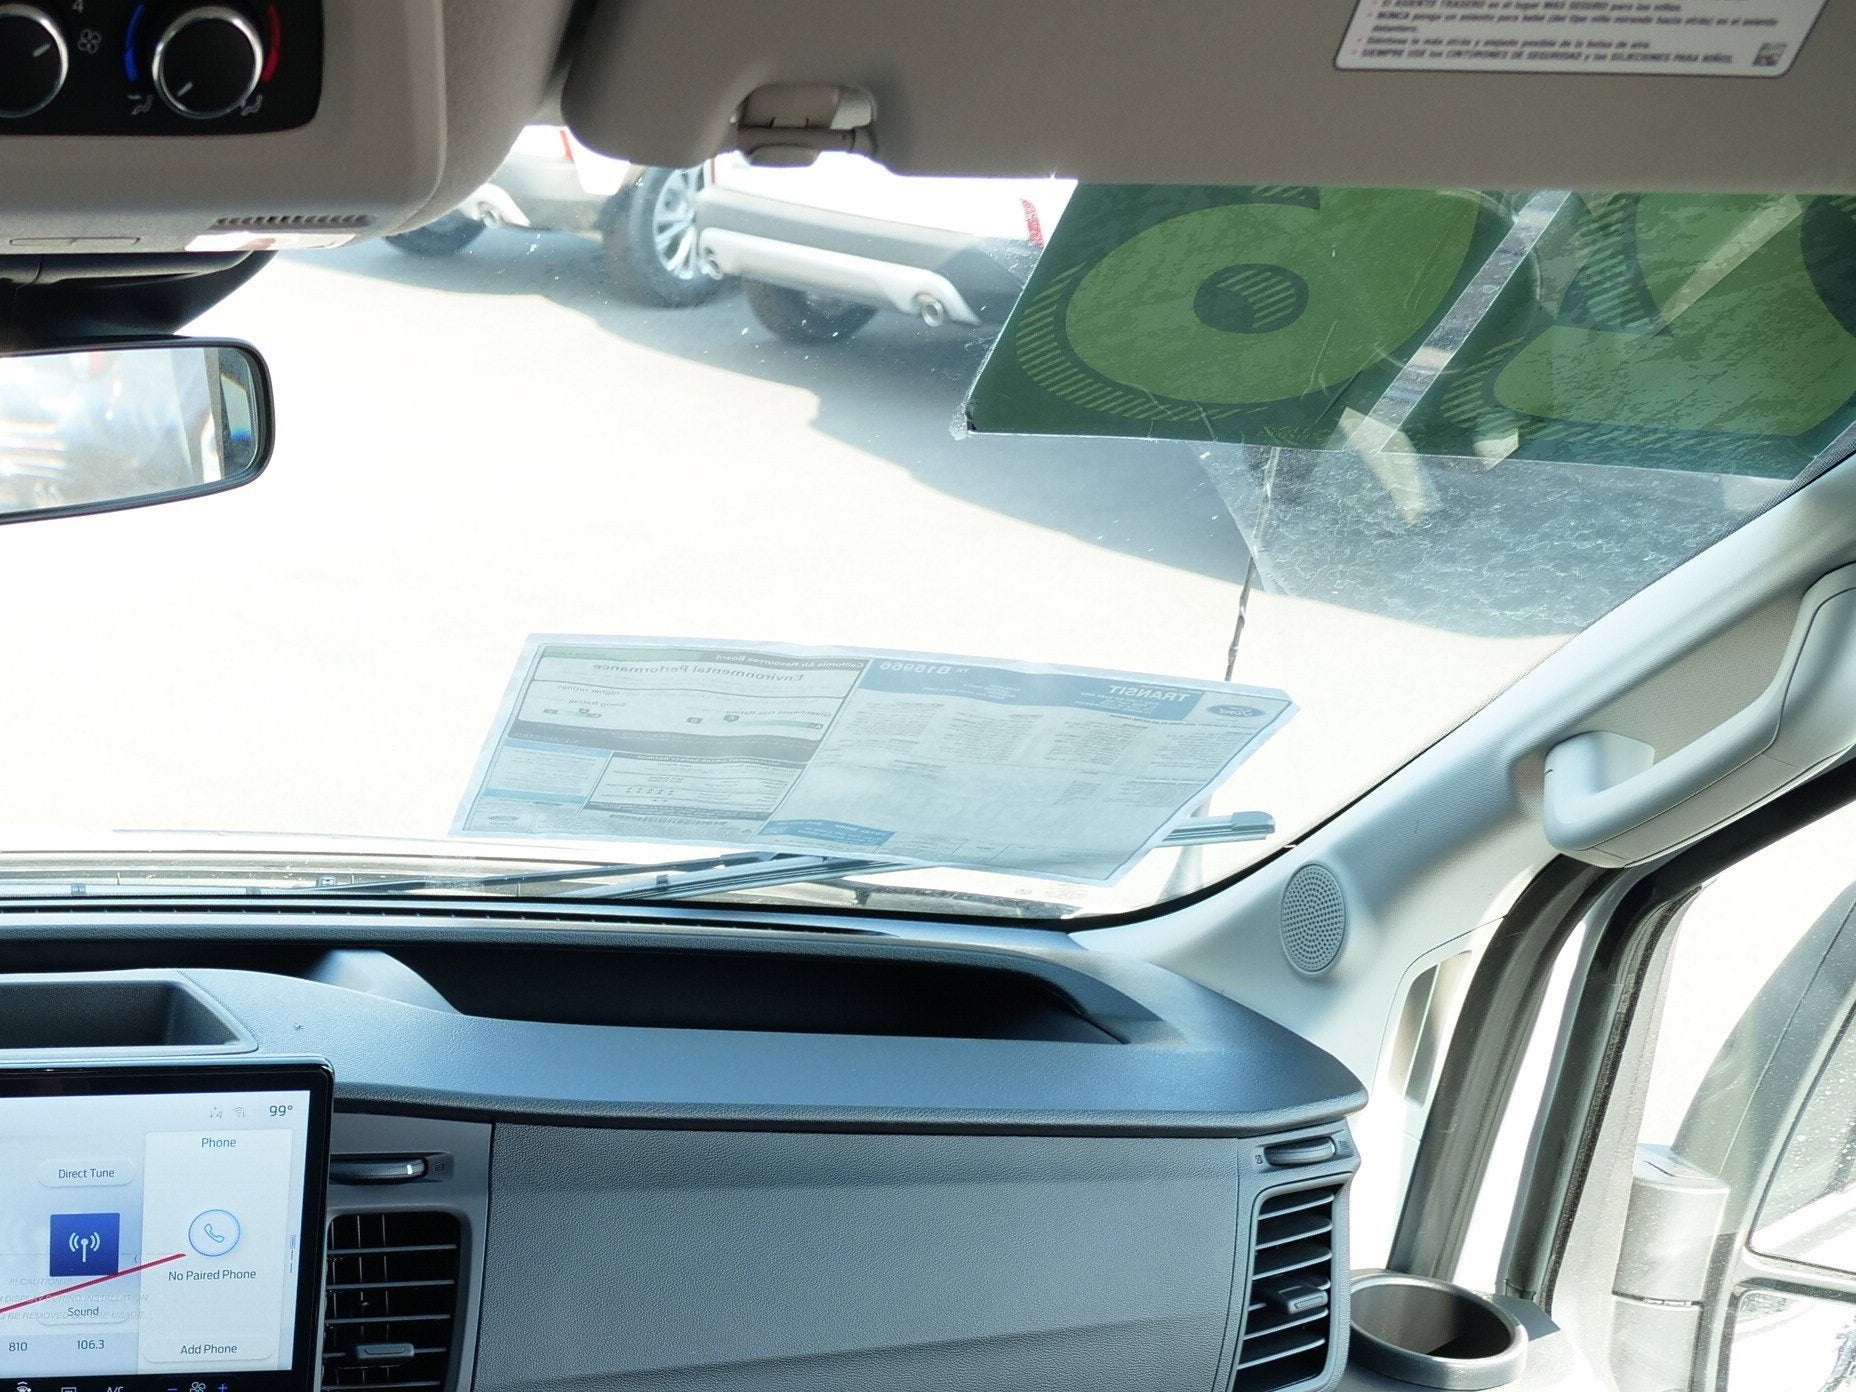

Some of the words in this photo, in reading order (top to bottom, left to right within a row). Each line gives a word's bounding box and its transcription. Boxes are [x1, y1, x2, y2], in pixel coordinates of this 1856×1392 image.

[269, 1104, 293, 1117] 99°
[201, 1137, 237, 1148] Phone
[58, 1168, 88, 1179] Direct
[90, 1167, 115, 1179] Tune
[168, 1271, 184, 1281] No
[186, 1269, 220, 1281] Paired
[222, 1269, 257, 1280] Phone
[67, 1306, 99, 1317] Sound
[8, 1342, 28, 1352] 810
[76, 1339, 105, 1350] 106.3
[180, 1345, 201, 1355] Add
[203, 1344, 238, 1354] Phone
